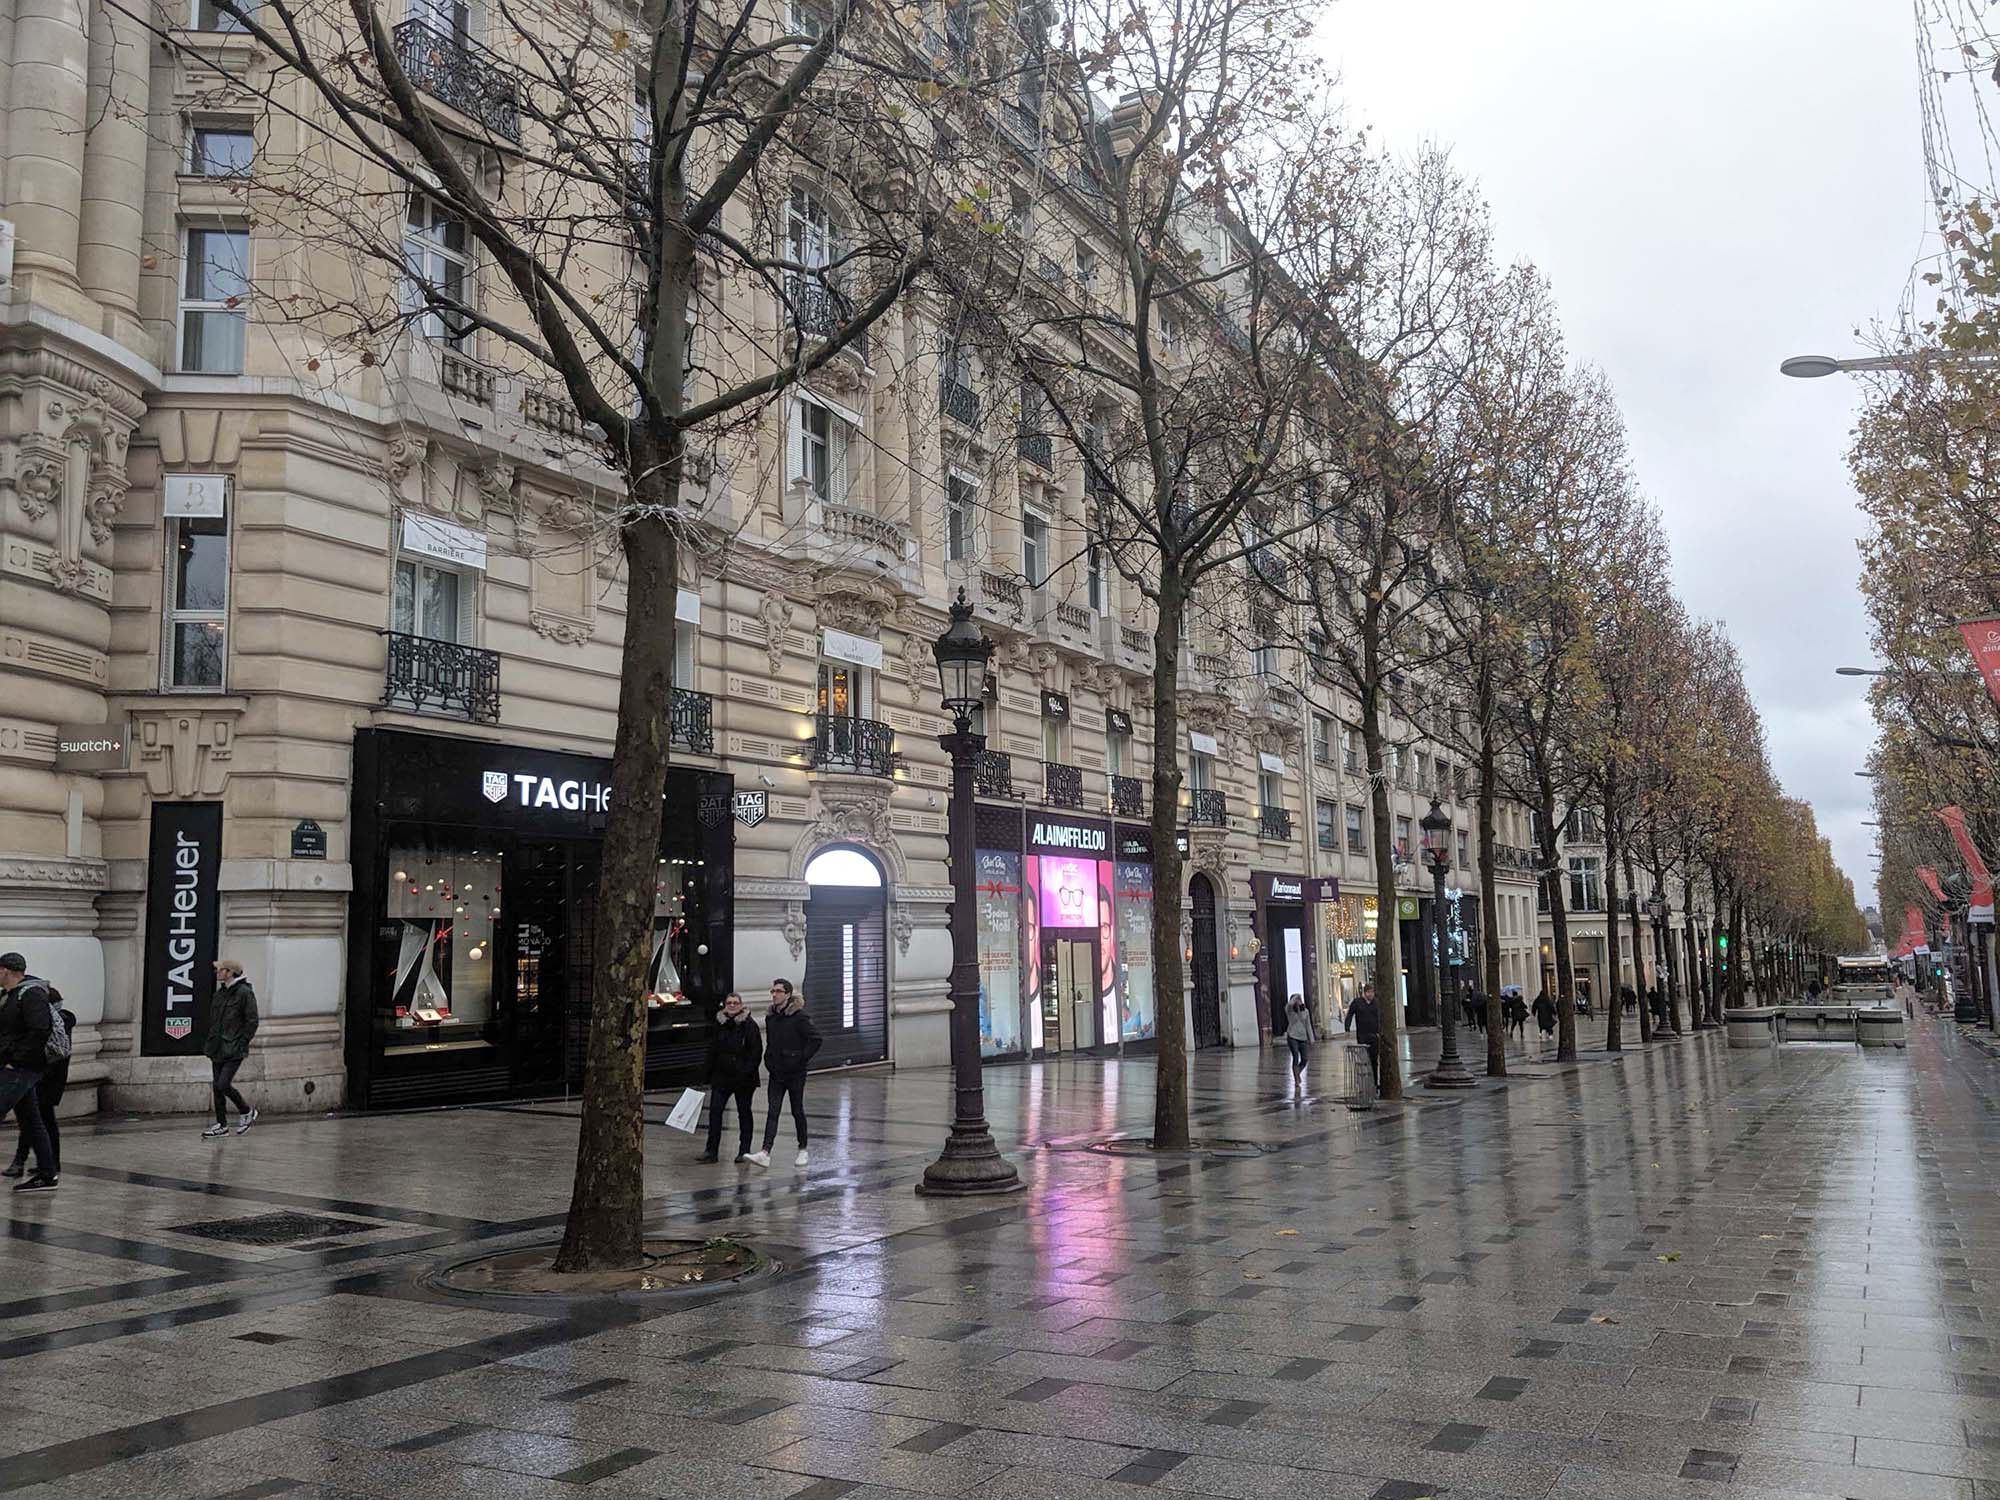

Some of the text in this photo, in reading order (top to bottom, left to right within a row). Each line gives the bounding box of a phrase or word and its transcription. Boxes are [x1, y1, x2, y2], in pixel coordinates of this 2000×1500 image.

[60, 740, 112, 752] swatch
[487, 773, 506, 784] TAG
[738, 793, 762, 805] TAG
[737, 807, 763, 824] HEUER
[1347, 943, 1377, 957] YVES ROC
[168, 1019, 189, 1027] TAG
